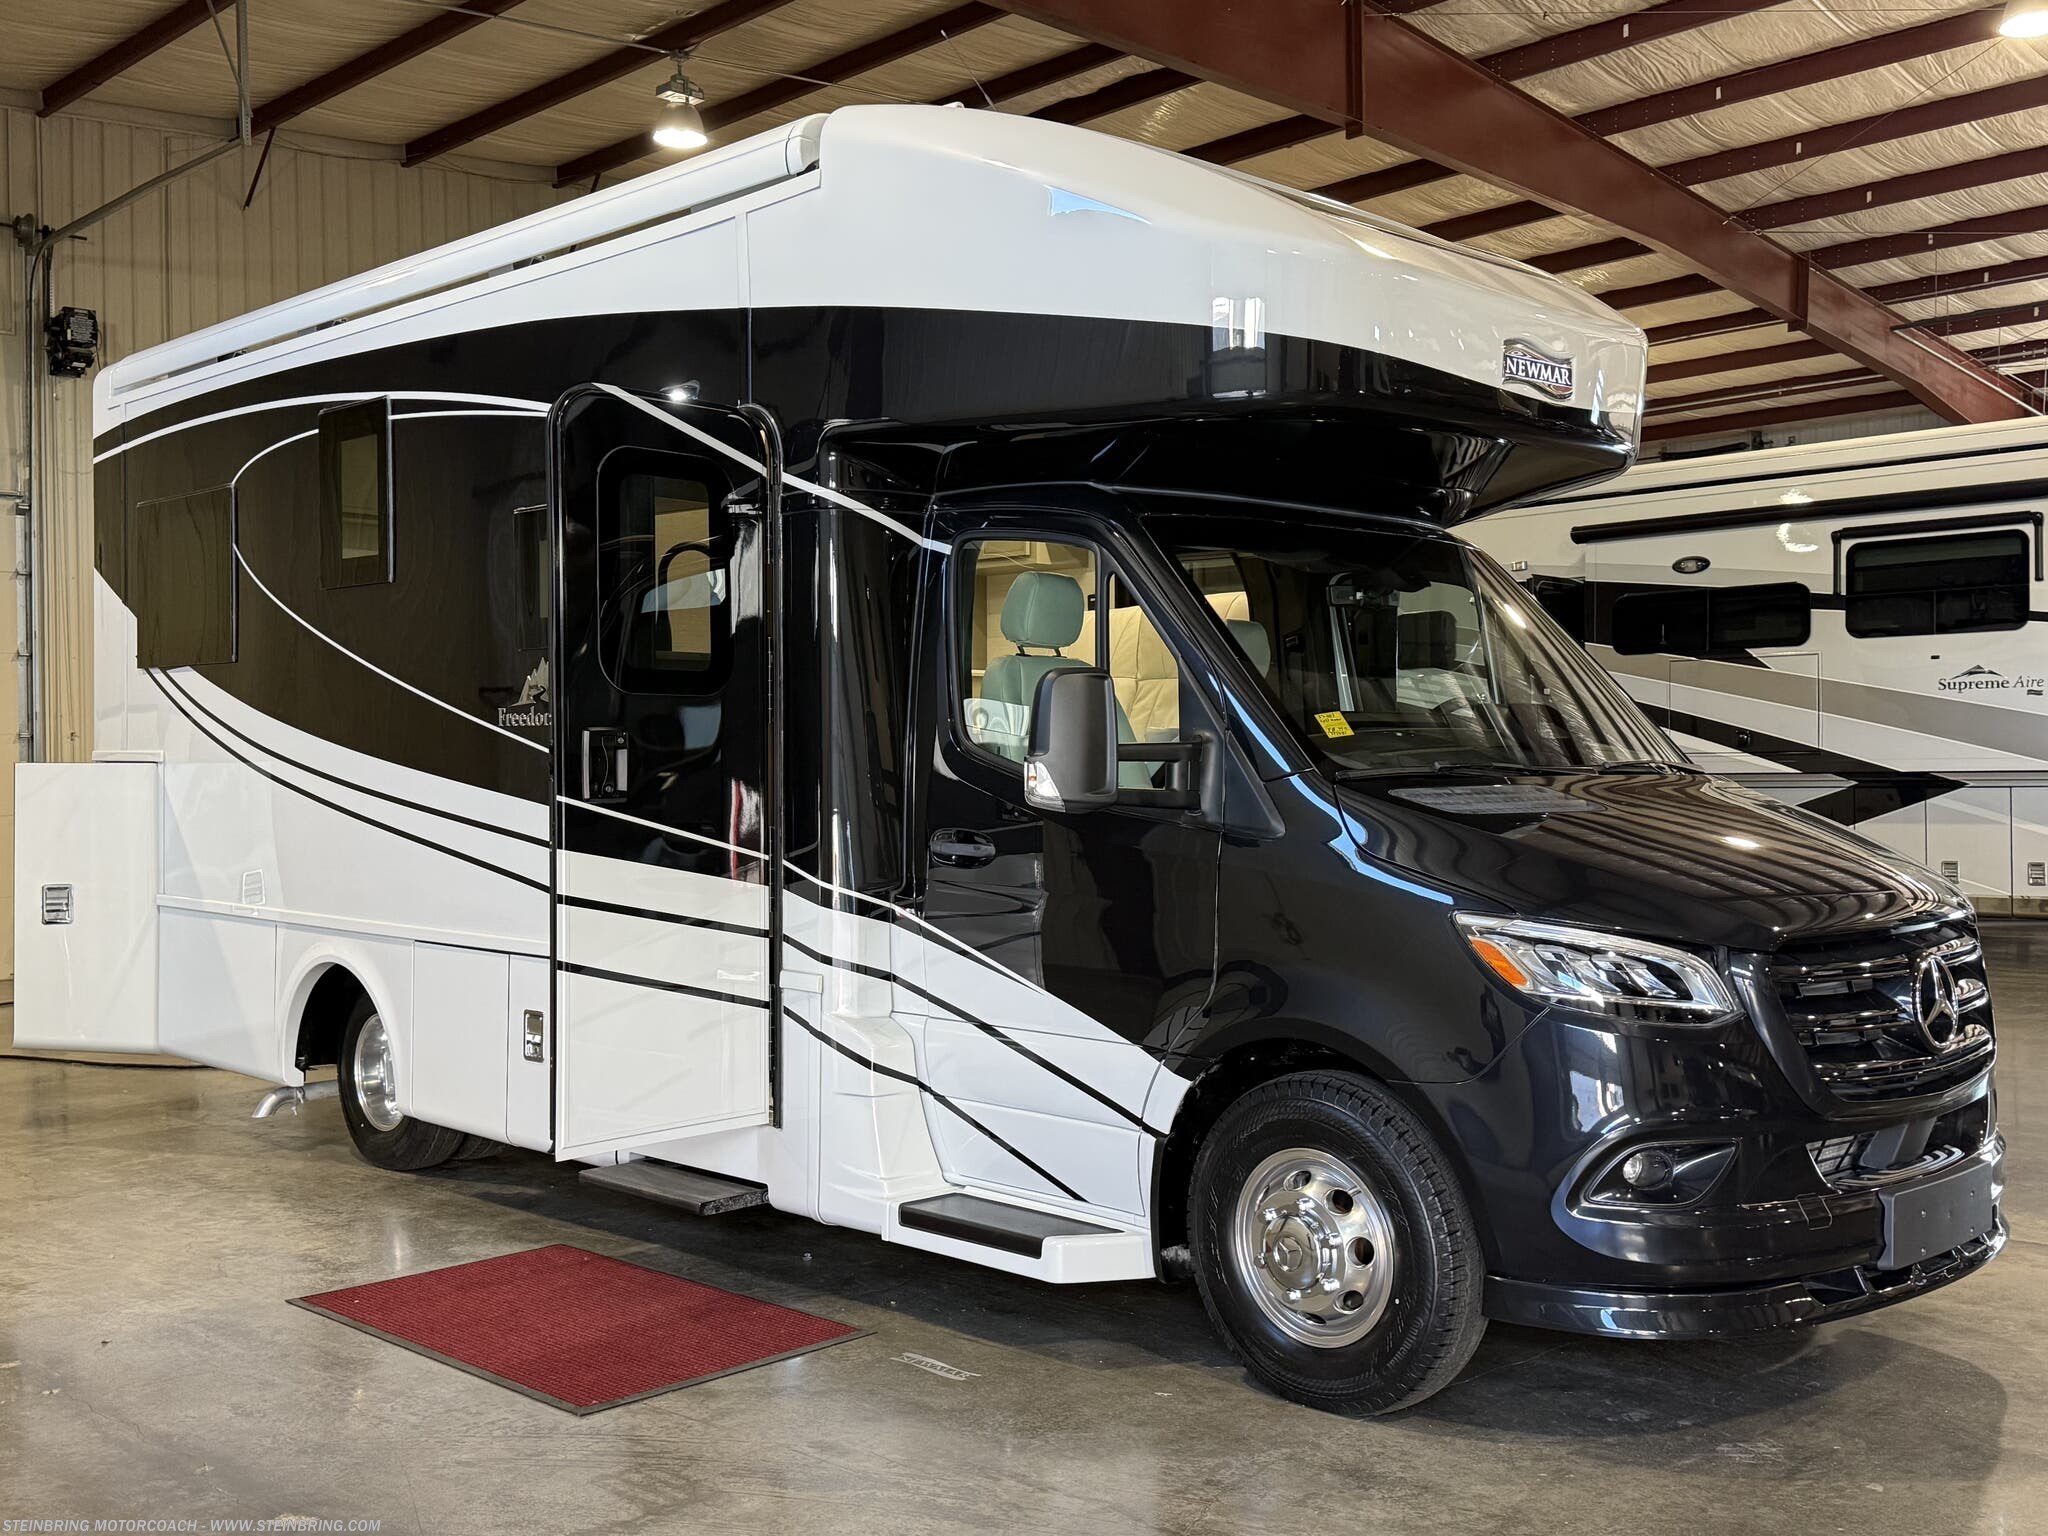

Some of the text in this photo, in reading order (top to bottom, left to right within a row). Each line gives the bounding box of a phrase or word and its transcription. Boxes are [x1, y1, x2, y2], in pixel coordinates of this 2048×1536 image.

[1506, 357, 1571, 385] NEWMAR
[1938, 676, 2045, 693] Supreme Aire
